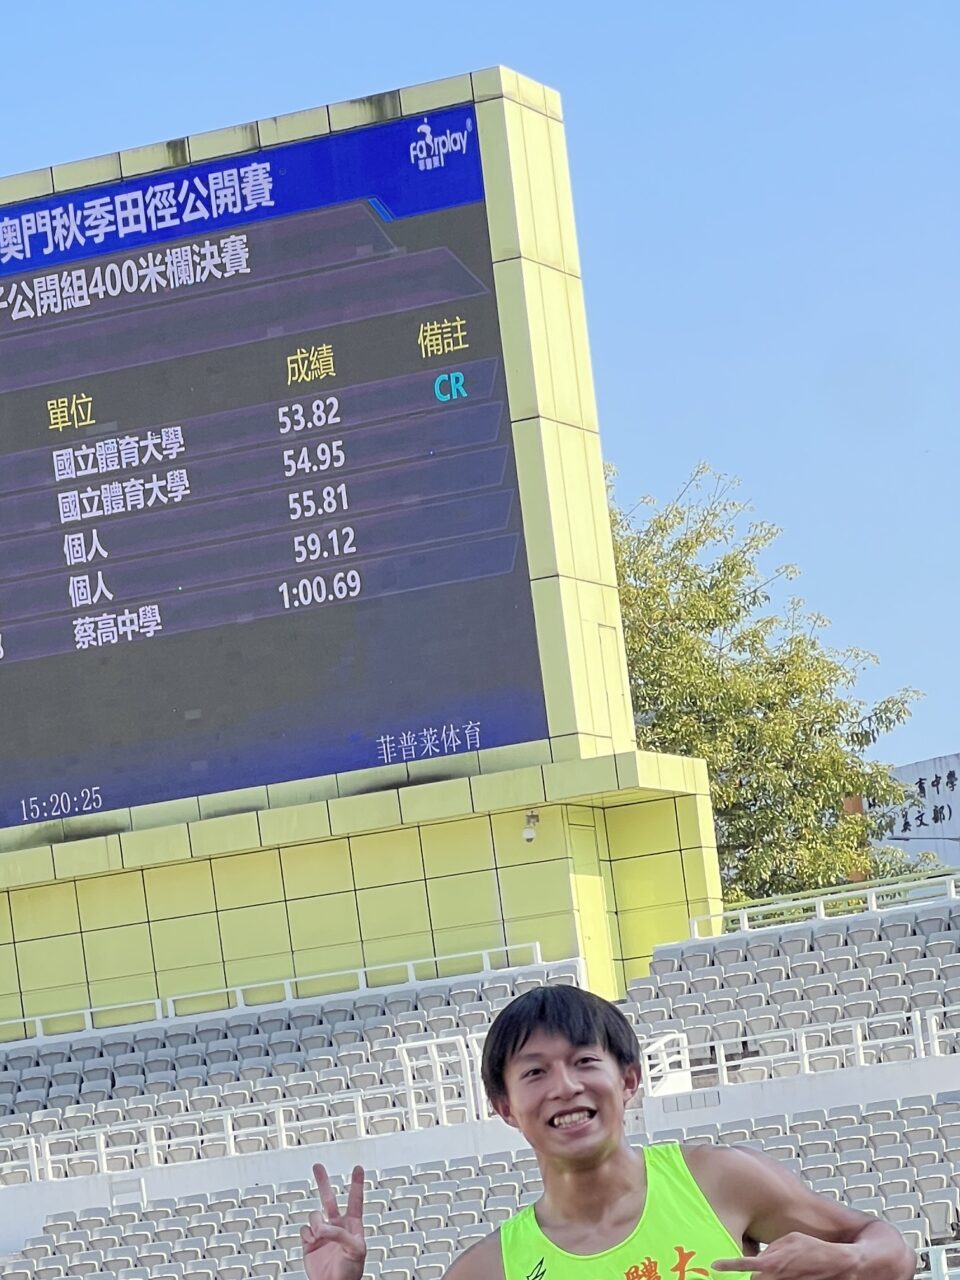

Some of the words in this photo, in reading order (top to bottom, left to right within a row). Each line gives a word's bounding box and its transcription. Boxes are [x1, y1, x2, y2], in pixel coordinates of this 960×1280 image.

[47, 393, 96, 432] 單位
[286, 343, 336, 386] 成績
[417, 316, 469, 359] 備註
[52, 426, 185, 482] 國立體育大學
[278, 397, 341, 434] 53.82
[434, 371, 468, 403] CR
[57, 469, 190, 524] 國立體育大學
[283, 440, 346, 477] 54.95
[63, 529, 108, 566] 個人
[288, 483, 349, 520] 55.81
[68, 571, 114, 607] 個人
[294, 526, 357, 563] 59.12
[73, 604, 163, 650] 蔡高中學
[278, 569, 361, 609] 1:00.69
[21, 786, 103, 822] 15:20:25
